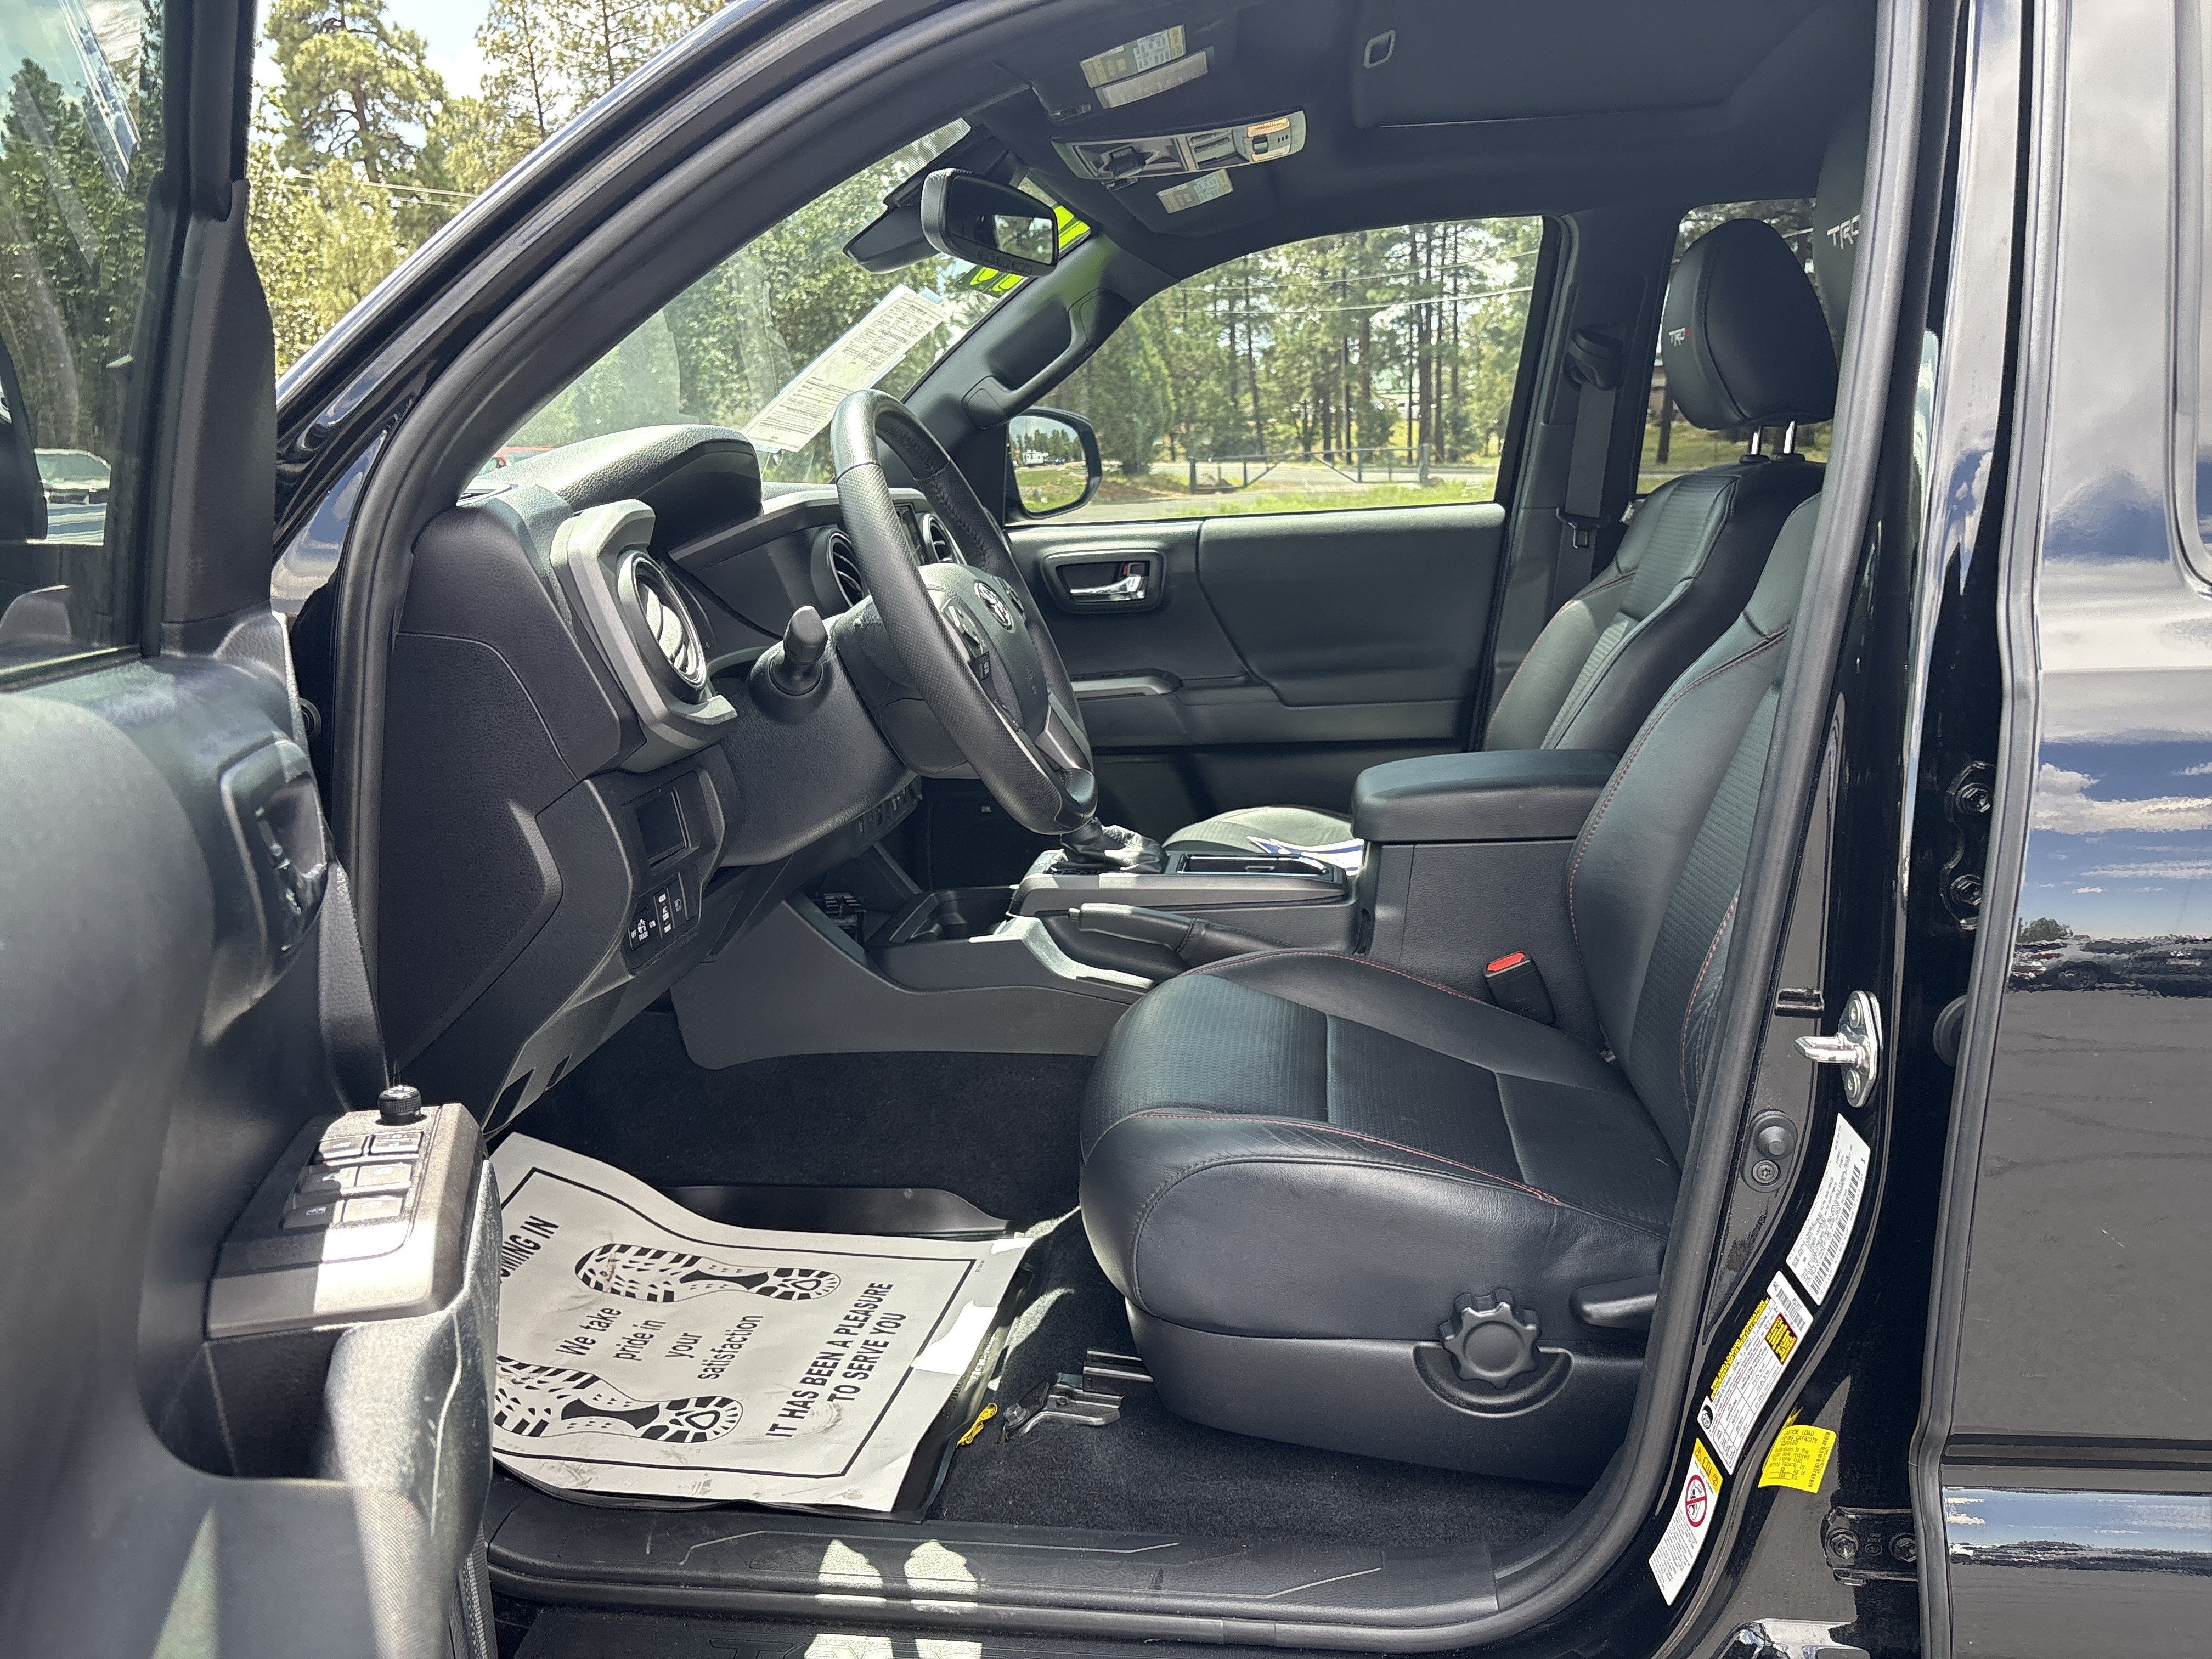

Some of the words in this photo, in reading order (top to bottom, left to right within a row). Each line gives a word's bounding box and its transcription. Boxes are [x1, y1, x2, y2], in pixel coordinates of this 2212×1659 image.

[520, 1215, 560, 1239] IN
[833, 1283, 894, 1336] PLEASURE
[555, 1336, 596, 1356] We
[579, 1308, 622, 1331] take
[632, 1319, 667, 1331] in
[869, 1312, 907, 1335] YOU
[613, 1333, 654, 1361] pride
[664, 1332, 703, 1359] your
[697, 1316, 764, 1380] satisfaction
[826, 1340, 854, 1348] A
[799, 1351, 845, 1386] BEEN
[842, 1339, 890, 1380] SERVE
[777, 1390, 819, 1419] HAS
[826, 1384, 861, 1402] TO
[765, 1423, 798, 1437] IT
